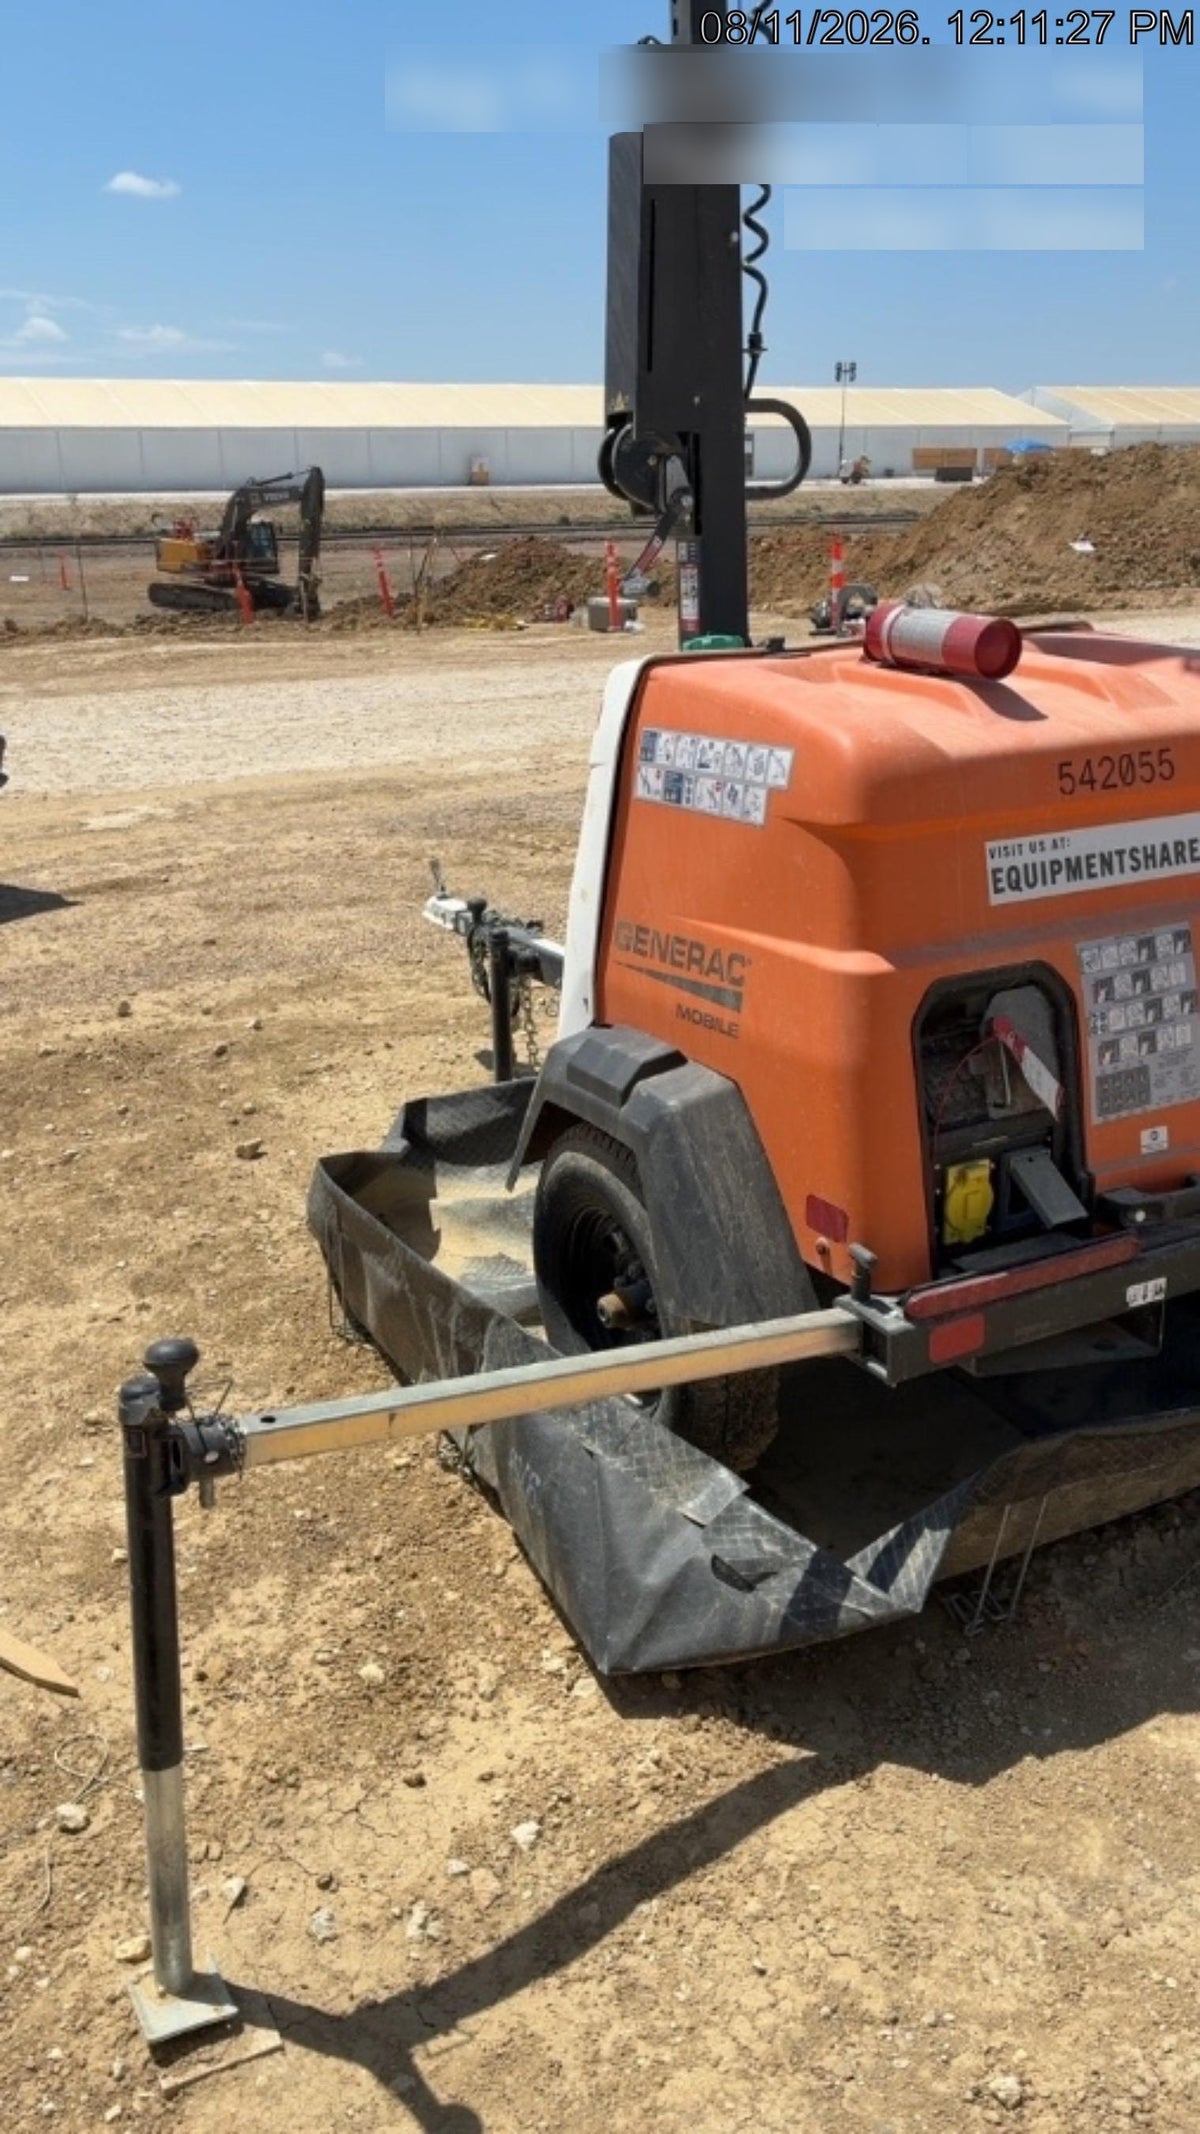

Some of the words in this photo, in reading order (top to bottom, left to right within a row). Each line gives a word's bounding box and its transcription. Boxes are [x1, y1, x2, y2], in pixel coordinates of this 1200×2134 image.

[1058, 748, 1175, 795] 542055
[988, 843, 1023, 859] VISIT
[1029, 841, 1045, 854] US
[1051, 837, 1070, 850] AT:
[991, 837, 1200, 895] EQUIPMENTSHARE
[615, 920, 746, 987] GENERAC
[675, 1004, 740, 1039] MOBILE
